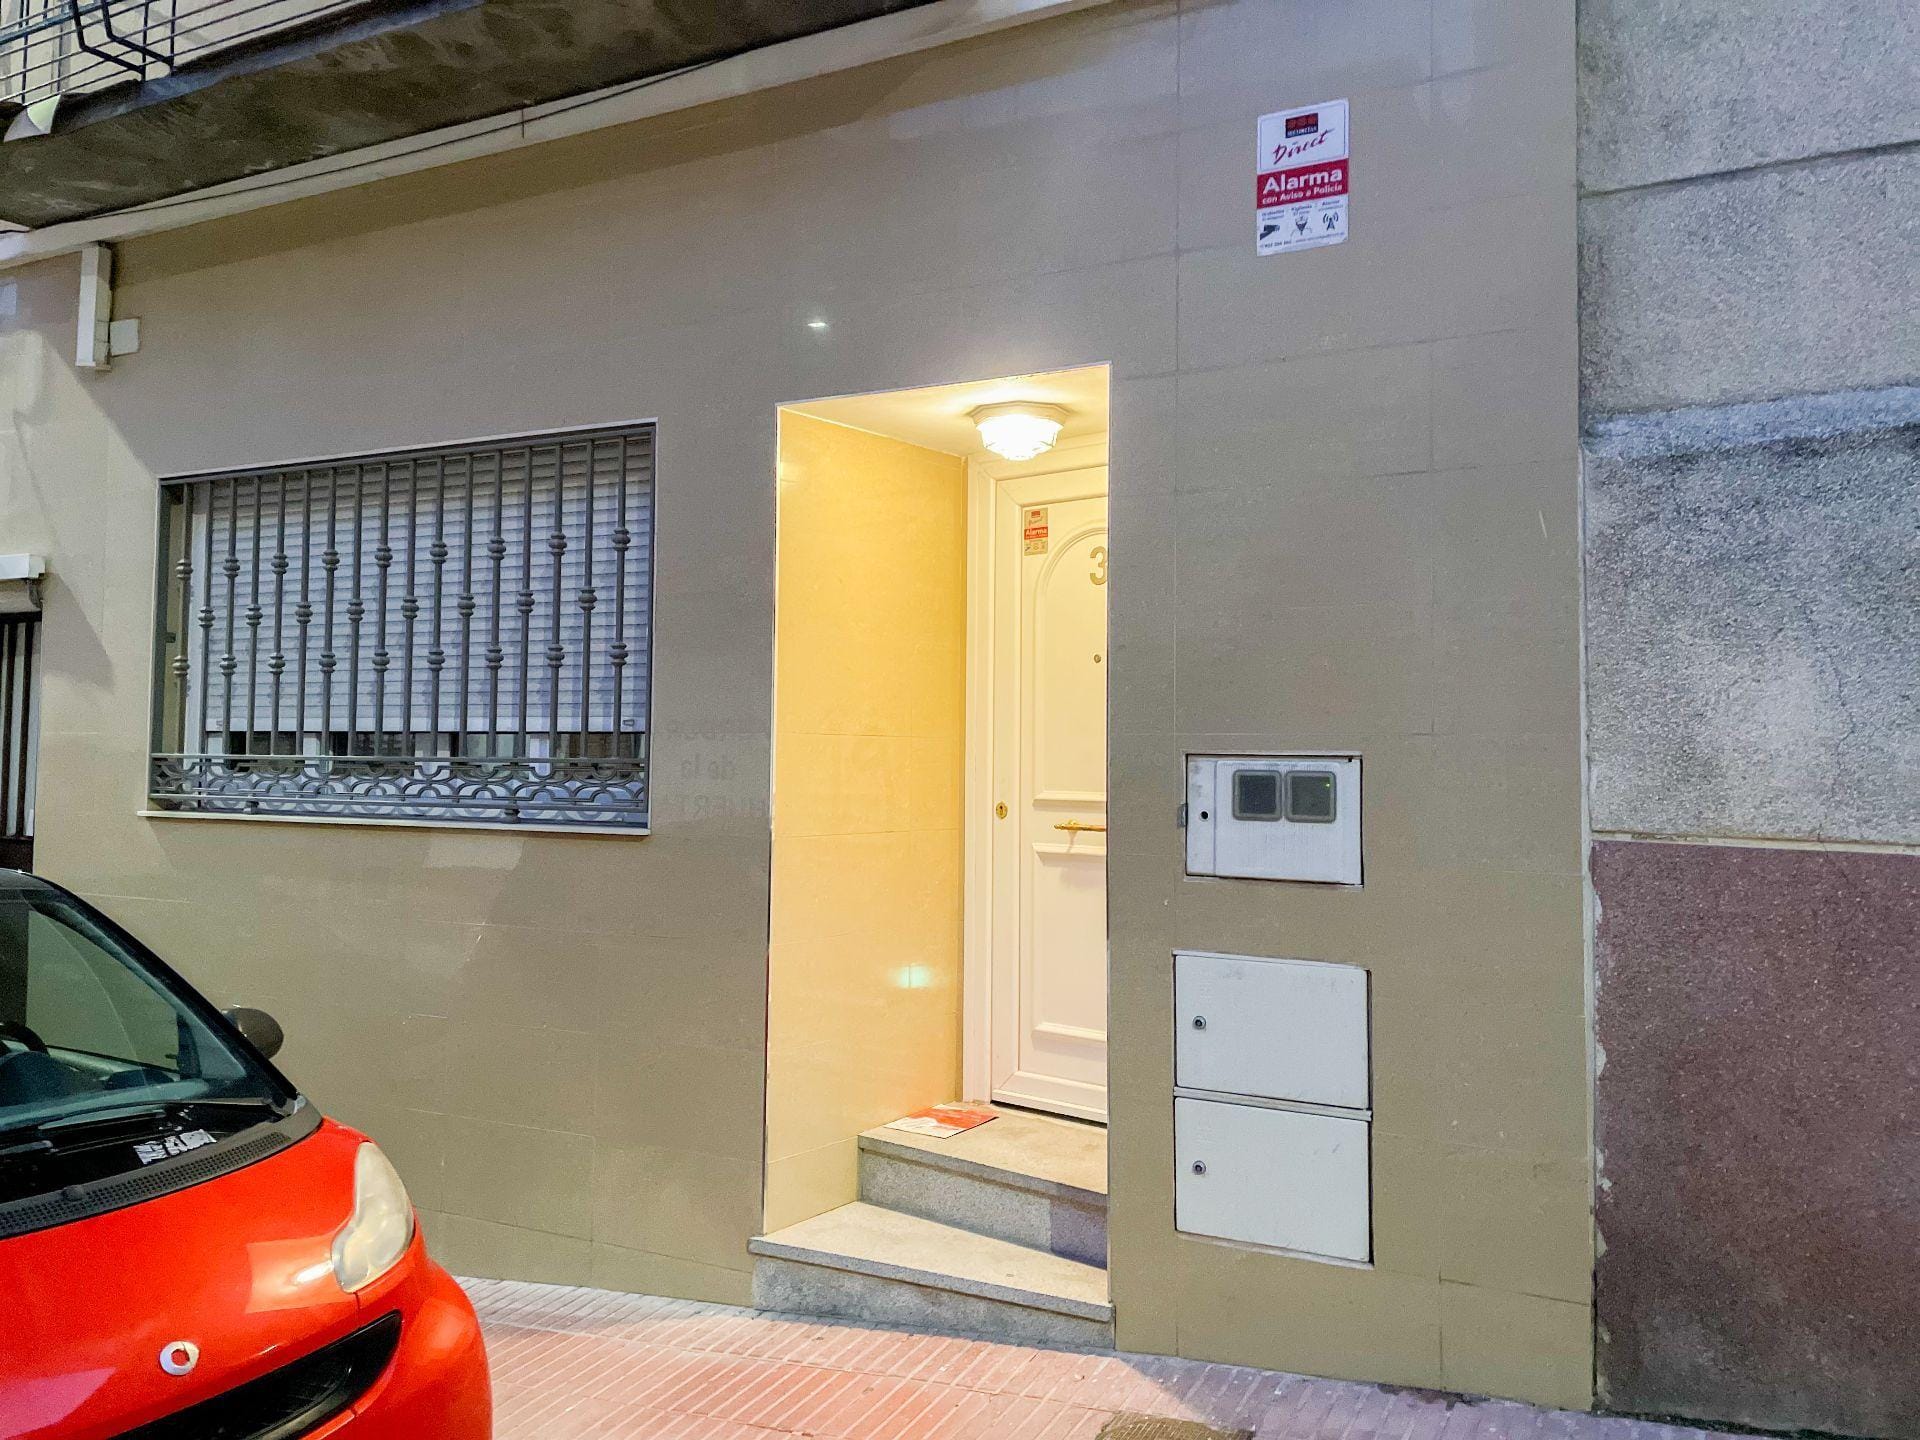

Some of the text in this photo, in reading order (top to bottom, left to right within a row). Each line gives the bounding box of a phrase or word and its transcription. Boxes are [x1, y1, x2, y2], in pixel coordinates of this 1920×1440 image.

[1273, 128, 1335, 164] Direct
[1263, 169, 1342, 194] Alarma
[1262, 196, 1278, 205] con
[1280, 190, 1304, 201] Aviso
[1026, 528, 1047, 536] Alarma
[1090, 546, 1107, 585] 3
